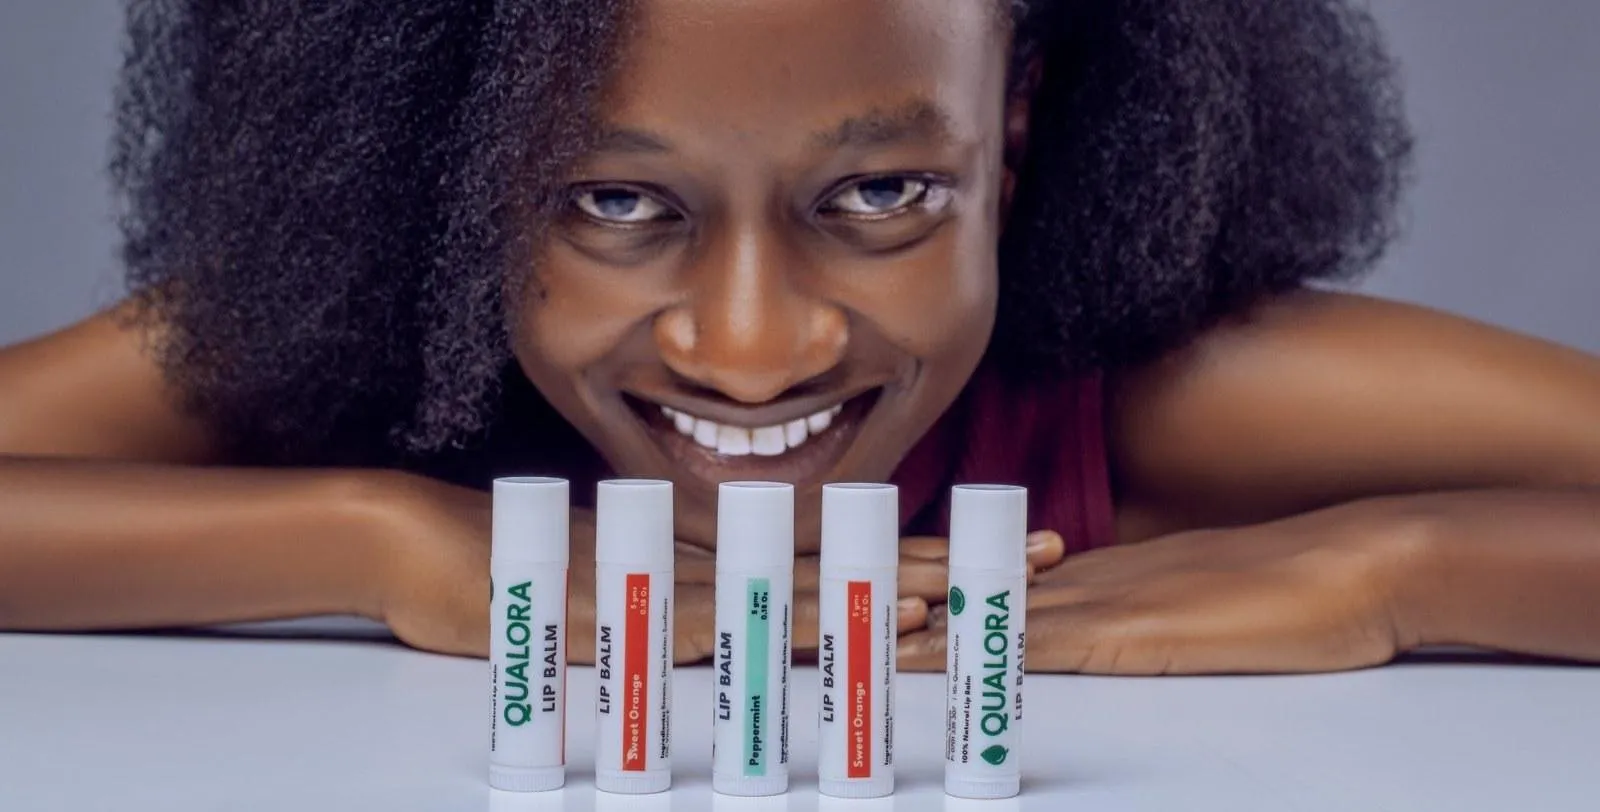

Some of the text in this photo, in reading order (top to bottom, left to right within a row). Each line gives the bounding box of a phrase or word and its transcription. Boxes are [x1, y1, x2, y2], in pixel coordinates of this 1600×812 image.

[503, 581, 532, 727] QUALORA
[542, 624, 558, 712] LIP BALM
[599, 625, 611, 714] LIP BALM
[719, 632, 732, 721] LIP BALM
[823, 634, 834, 723] LIP BALM
[980, 590, 1010, 737] QUALORA
[1015, 632, 1025, 721] LIP BALM
[628, 674, 642, 760] Sweet Orange
[749, 695, 762, 766] Peppermint
[853, 682, 865, 768] Sweet Orange
[964, 697, 972, 709] Lip
